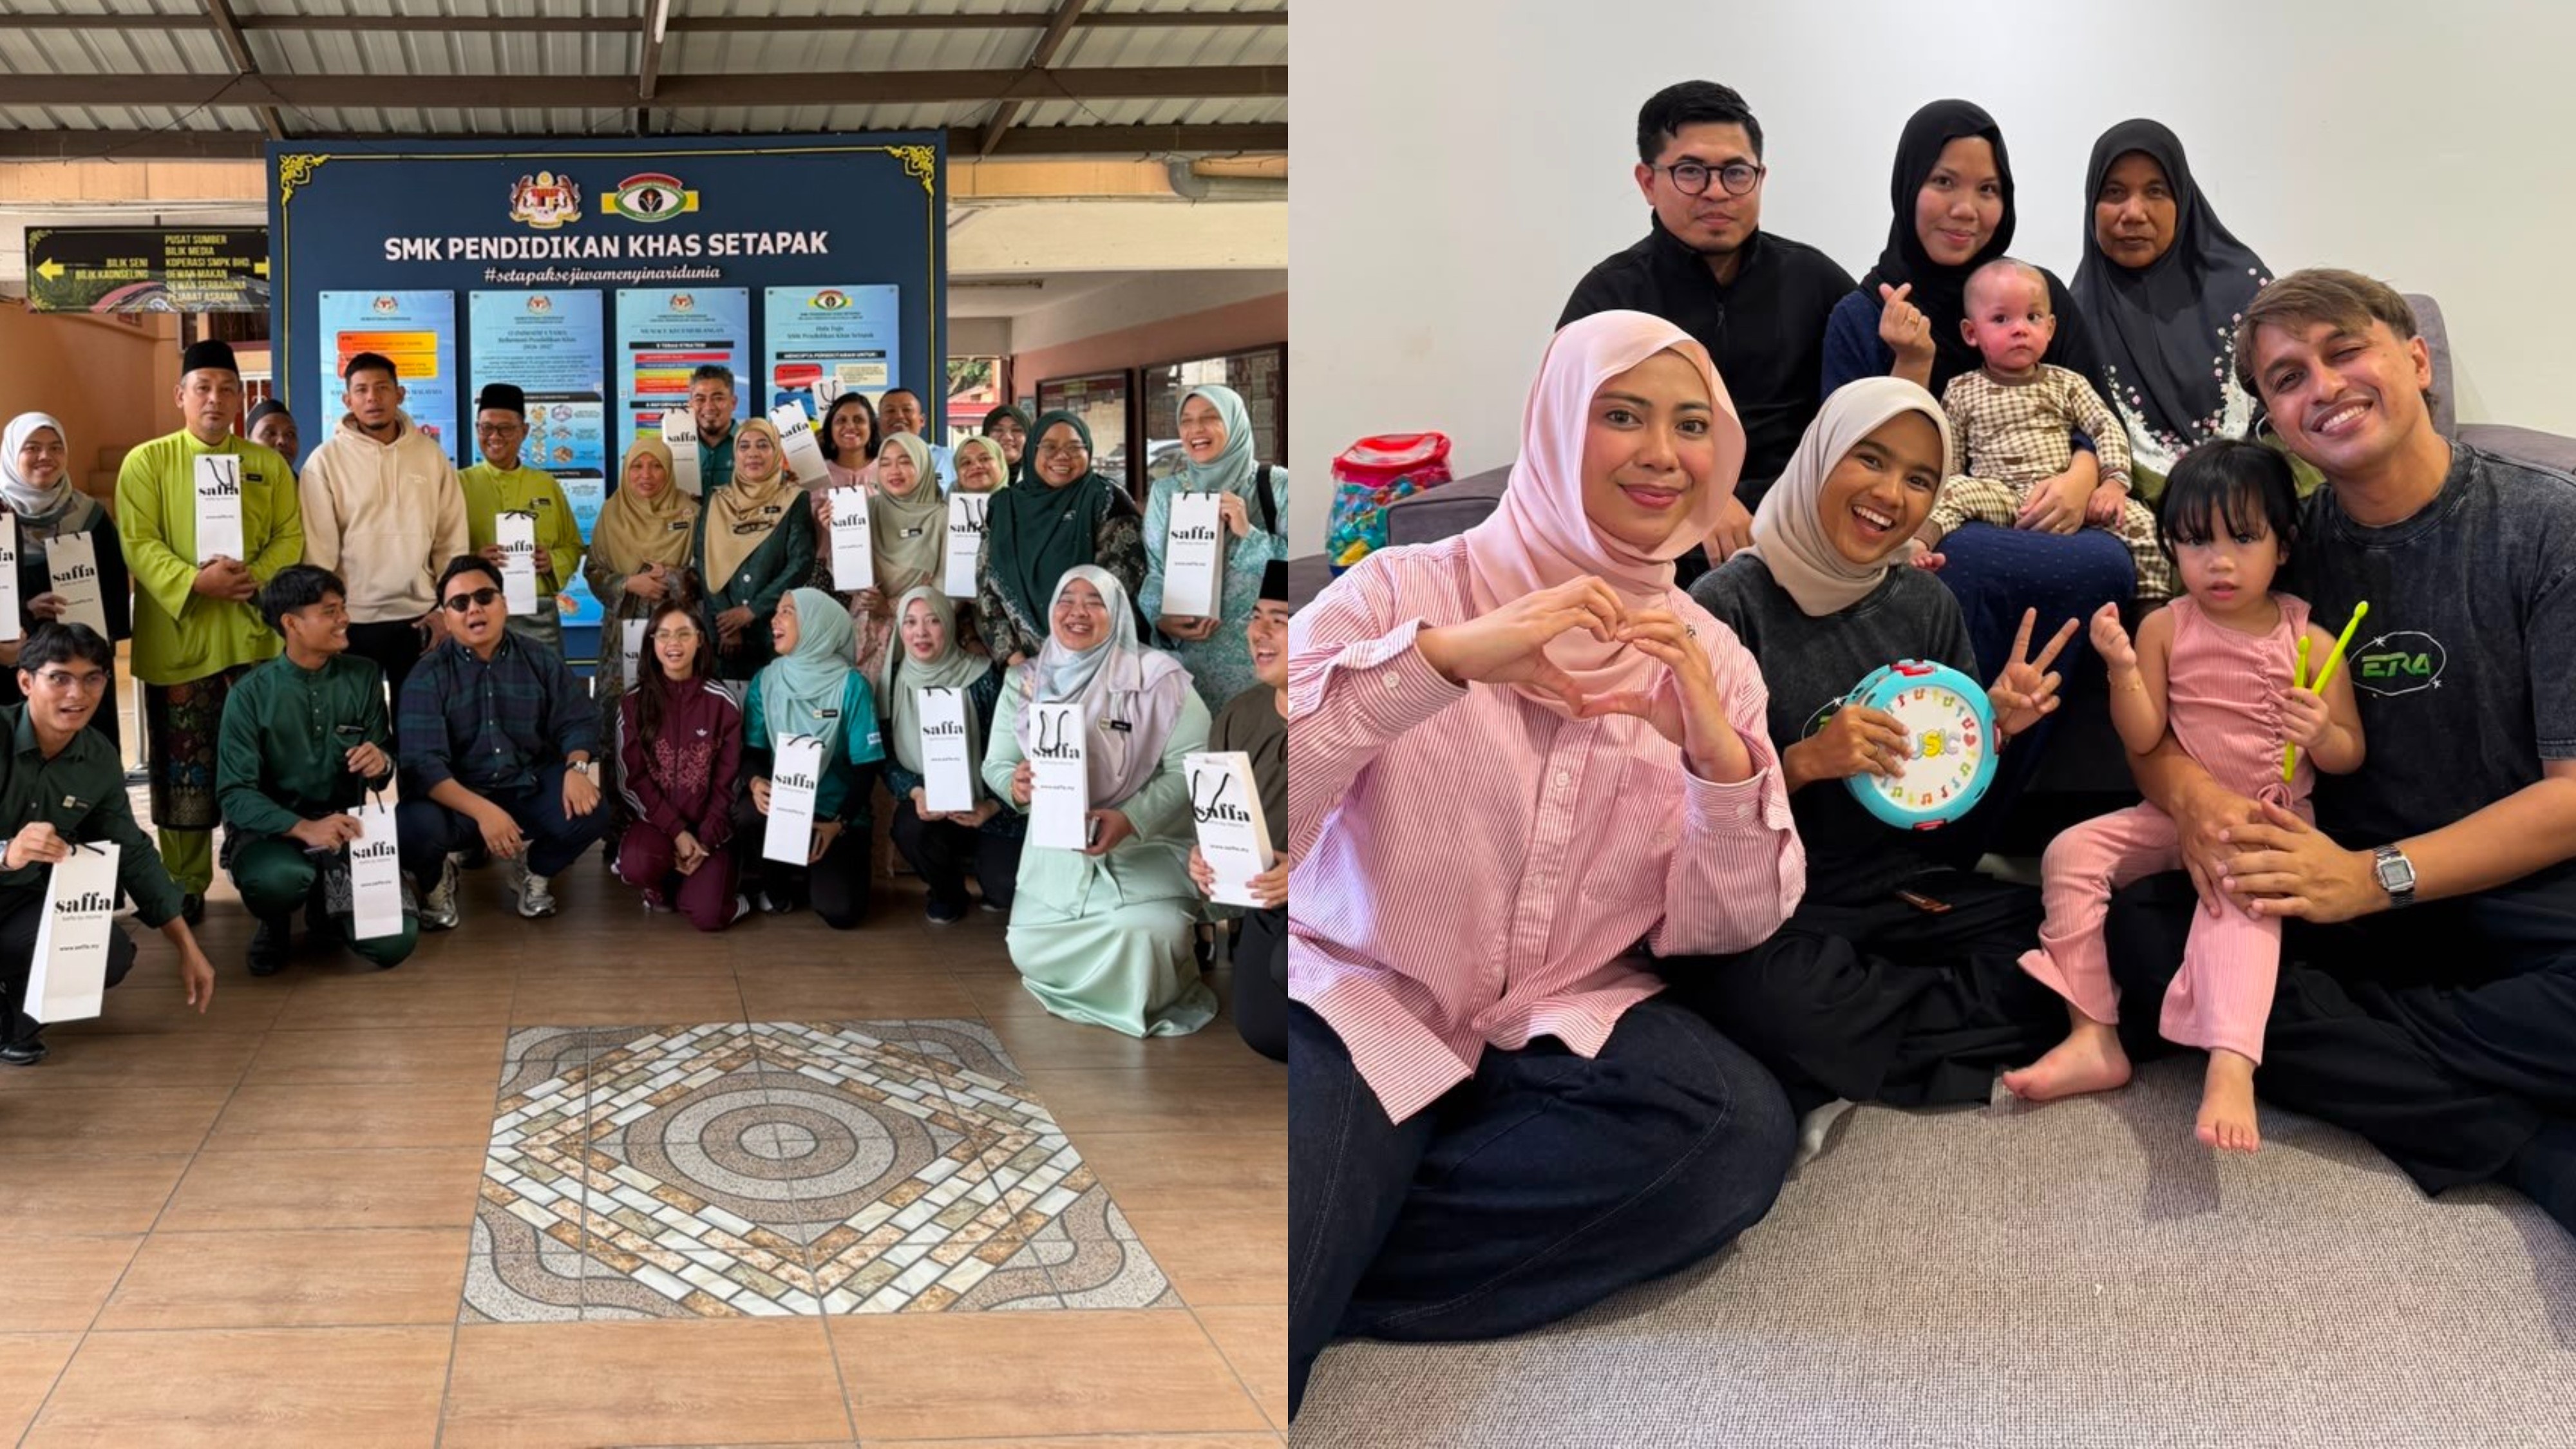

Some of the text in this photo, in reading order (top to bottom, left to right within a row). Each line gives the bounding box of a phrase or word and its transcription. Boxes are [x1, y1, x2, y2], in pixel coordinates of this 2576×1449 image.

[165, 235, 227, 244] PUSAT SUMBER
[384, 231, 828, 260] SMK PENDIDIKAN KHAS SETAPAK
[165, 247, 214, 256] BILIK MEDIA
[106, 258, 148, 268] BILIK SENI
[166, 258, 205, 267] KOPERASI
[207, 258, 231, 267] SMPK
[75, 270, 97, 279] BILIK
[166, 269, 227, 279] DEWAN MAKAN
[484, 263, 721, 285] #setapaksejiwamenyinaridunia
[668, 431, 697, 442] saffa
[832, 513, 867, 527] saffa
[1170, 526, 1215, 540] saffa
[505, 540, 533, 553] affa
[52, 564, 95, 582] saffa
[2361, 652, 2432, 677] ERA
[923, 721, 964, 736] saffa
[1032, 742, 1081, 759] saffa
[775, 773, 815, 790] saffa
[1195, 803, 1251, 822] saffa
[352, 840, 395, 859] saffa
[54, 891, 111, 914] saffa
